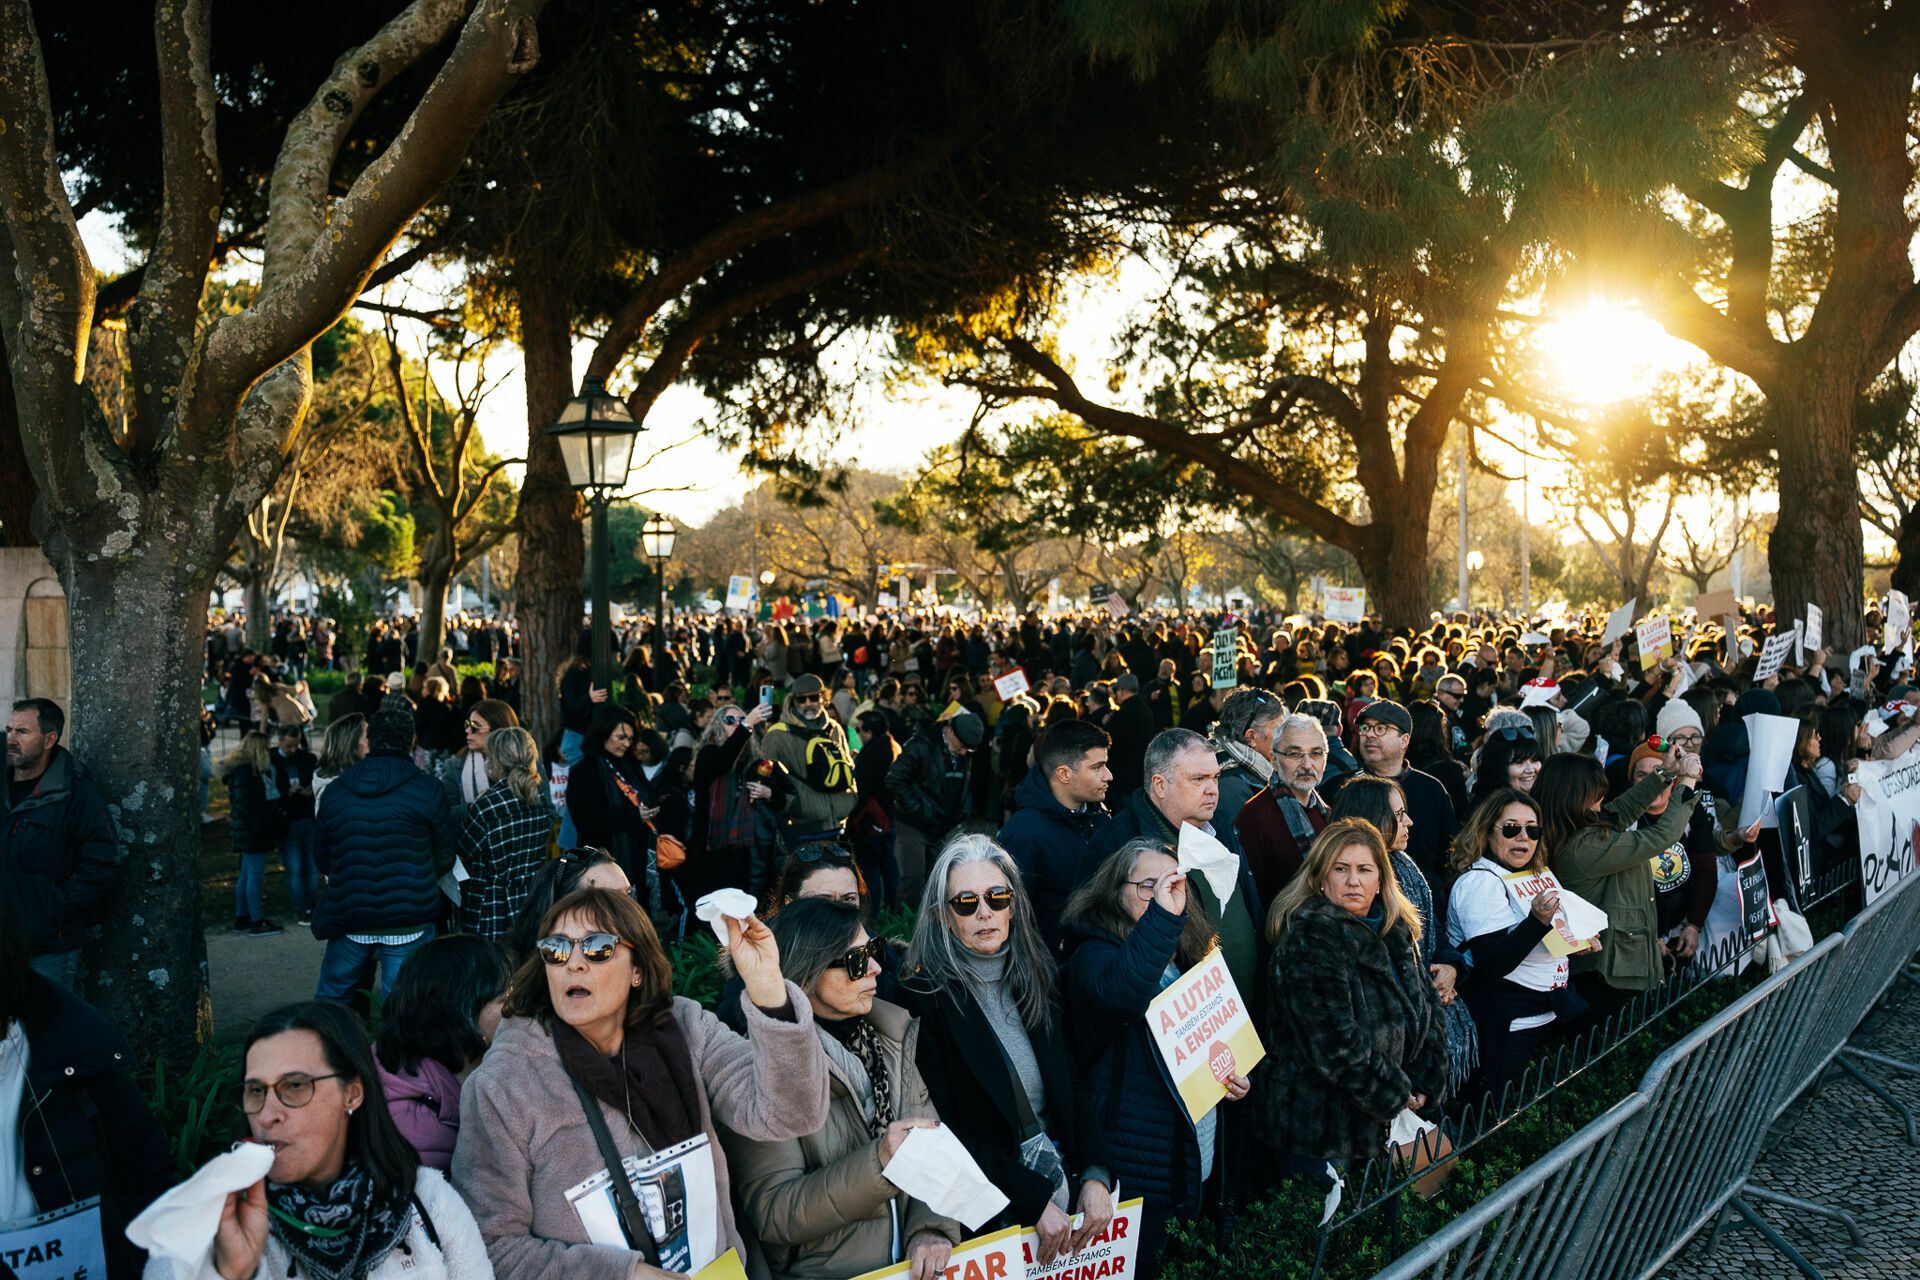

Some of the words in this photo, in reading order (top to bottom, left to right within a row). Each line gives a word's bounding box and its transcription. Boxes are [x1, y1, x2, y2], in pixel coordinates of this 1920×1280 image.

[1514, 883, 1526, 898] A
[1160, 1009, 1176, 1035] A
[1172, 966, 1226, 1021] LUTAR
[1175, 1014, 1200, 1040] TAMBÉM
[1198, 992, 1224, 1022] ESTAMOS
[1174, 1045, 1188, 1066] A
[1184, 998, 1239, 1054] ENSINAR
[1026, 1258, 1066, 1278] TAMBÉM
[1068, 1246, 1112, 1266] ESTAMOS
